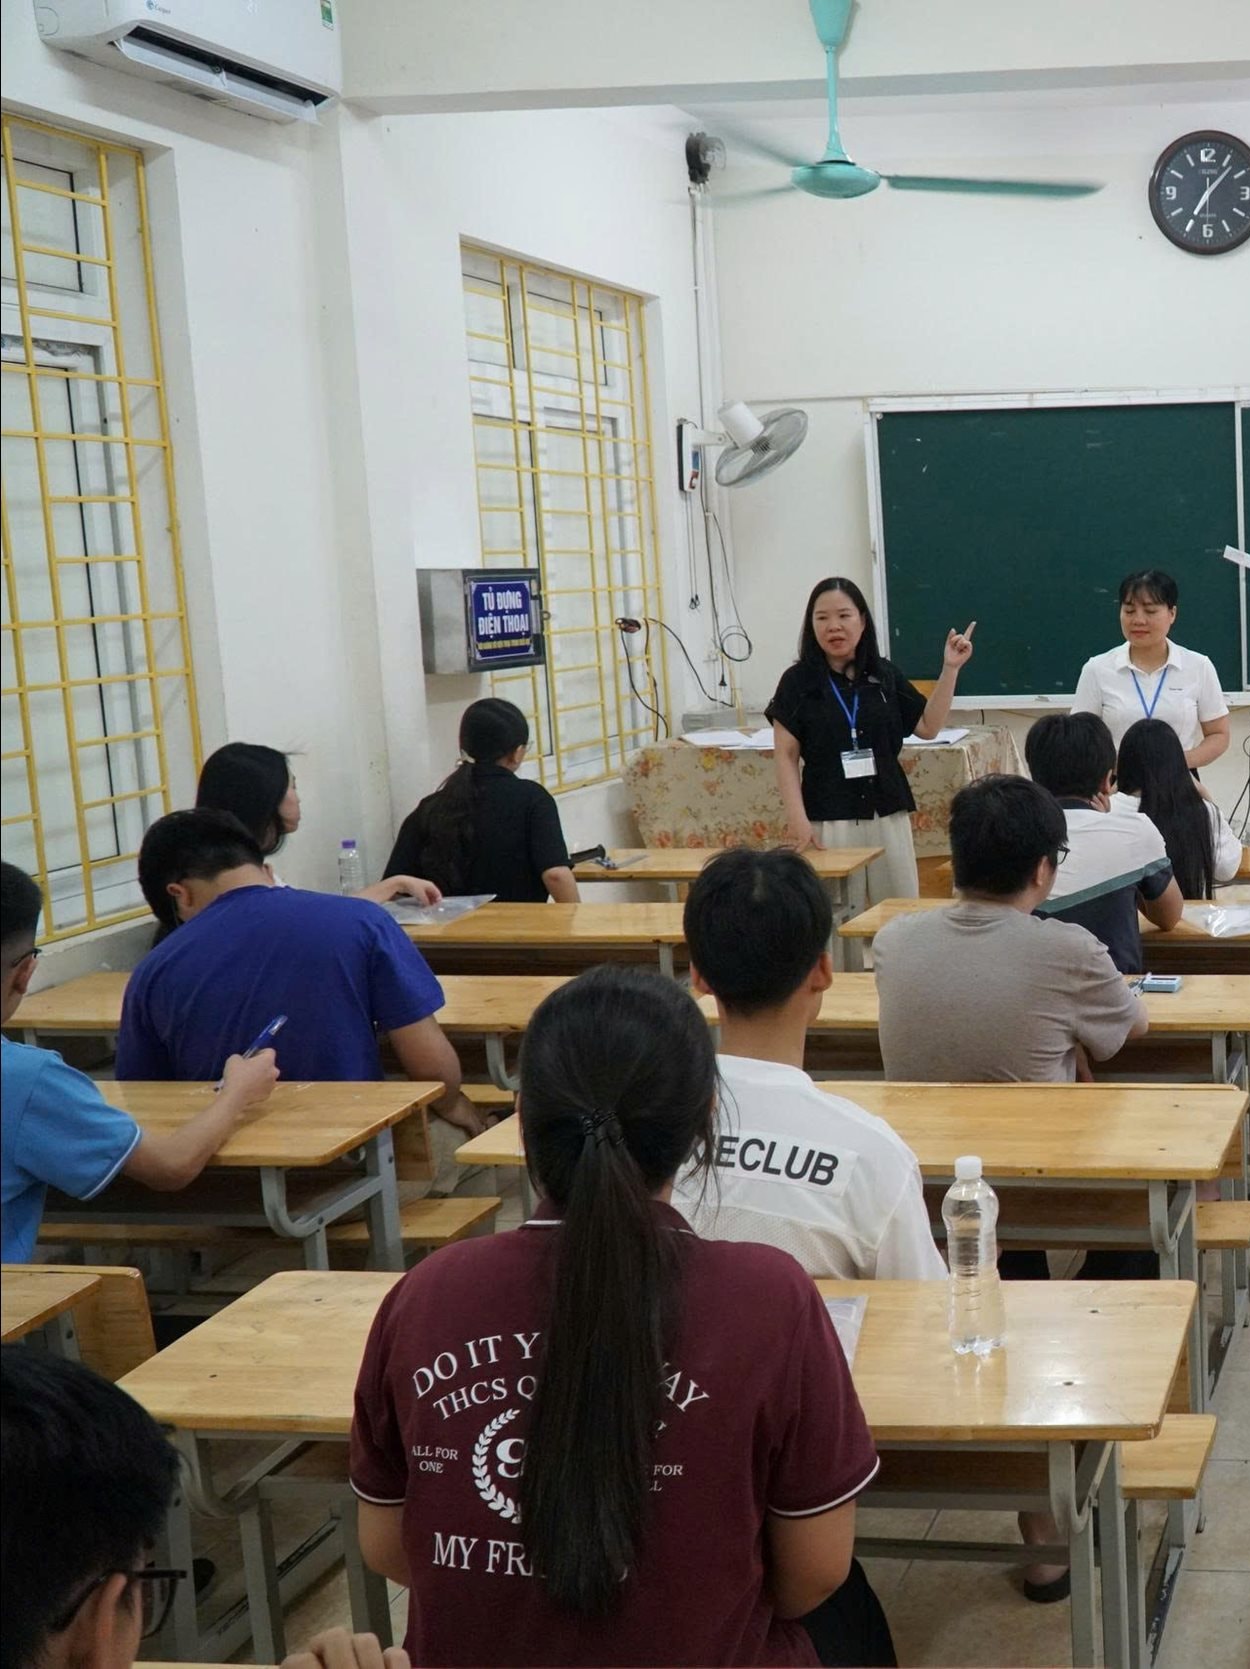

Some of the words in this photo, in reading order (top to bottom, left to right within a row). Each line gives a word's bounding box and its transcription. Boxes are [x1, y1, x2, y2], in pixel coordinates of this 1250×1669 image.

[1200, 148, 1216, 162] 12
[1165, 186, 1177, 200] 9
[1240, 186, 1250, 200] 3
[1202, 224, 1213, 238] 6
[482, 586, 494, 611] TỦ
[497, 590, 522, 613] ĐỰNG
[478, 613, 501, 638] ĐIỆN
[502, 614, 529, 636] THOẠI
[692, 1135, 839, 1186] ECLUB
[412, 1352, 458, 1399] DO
[464, 1335, 502, 1368] IT
[513, 1332, 541, 1359] Y
[660, 1362, 710, 1412] AY
[432, 1378, 508, 1420] THCS
[517, 1375, 538, 1400] Q
[412, 1445, 433, 1457] ALL
[435, 1447, 459, 1460] FOR
[419, 1461, 444, 1473] ONE
[653, 1464, 683, 1476] FOR
[433, 1532, 479, 1570] MY
[485, 1539, 534, 1577] FR
